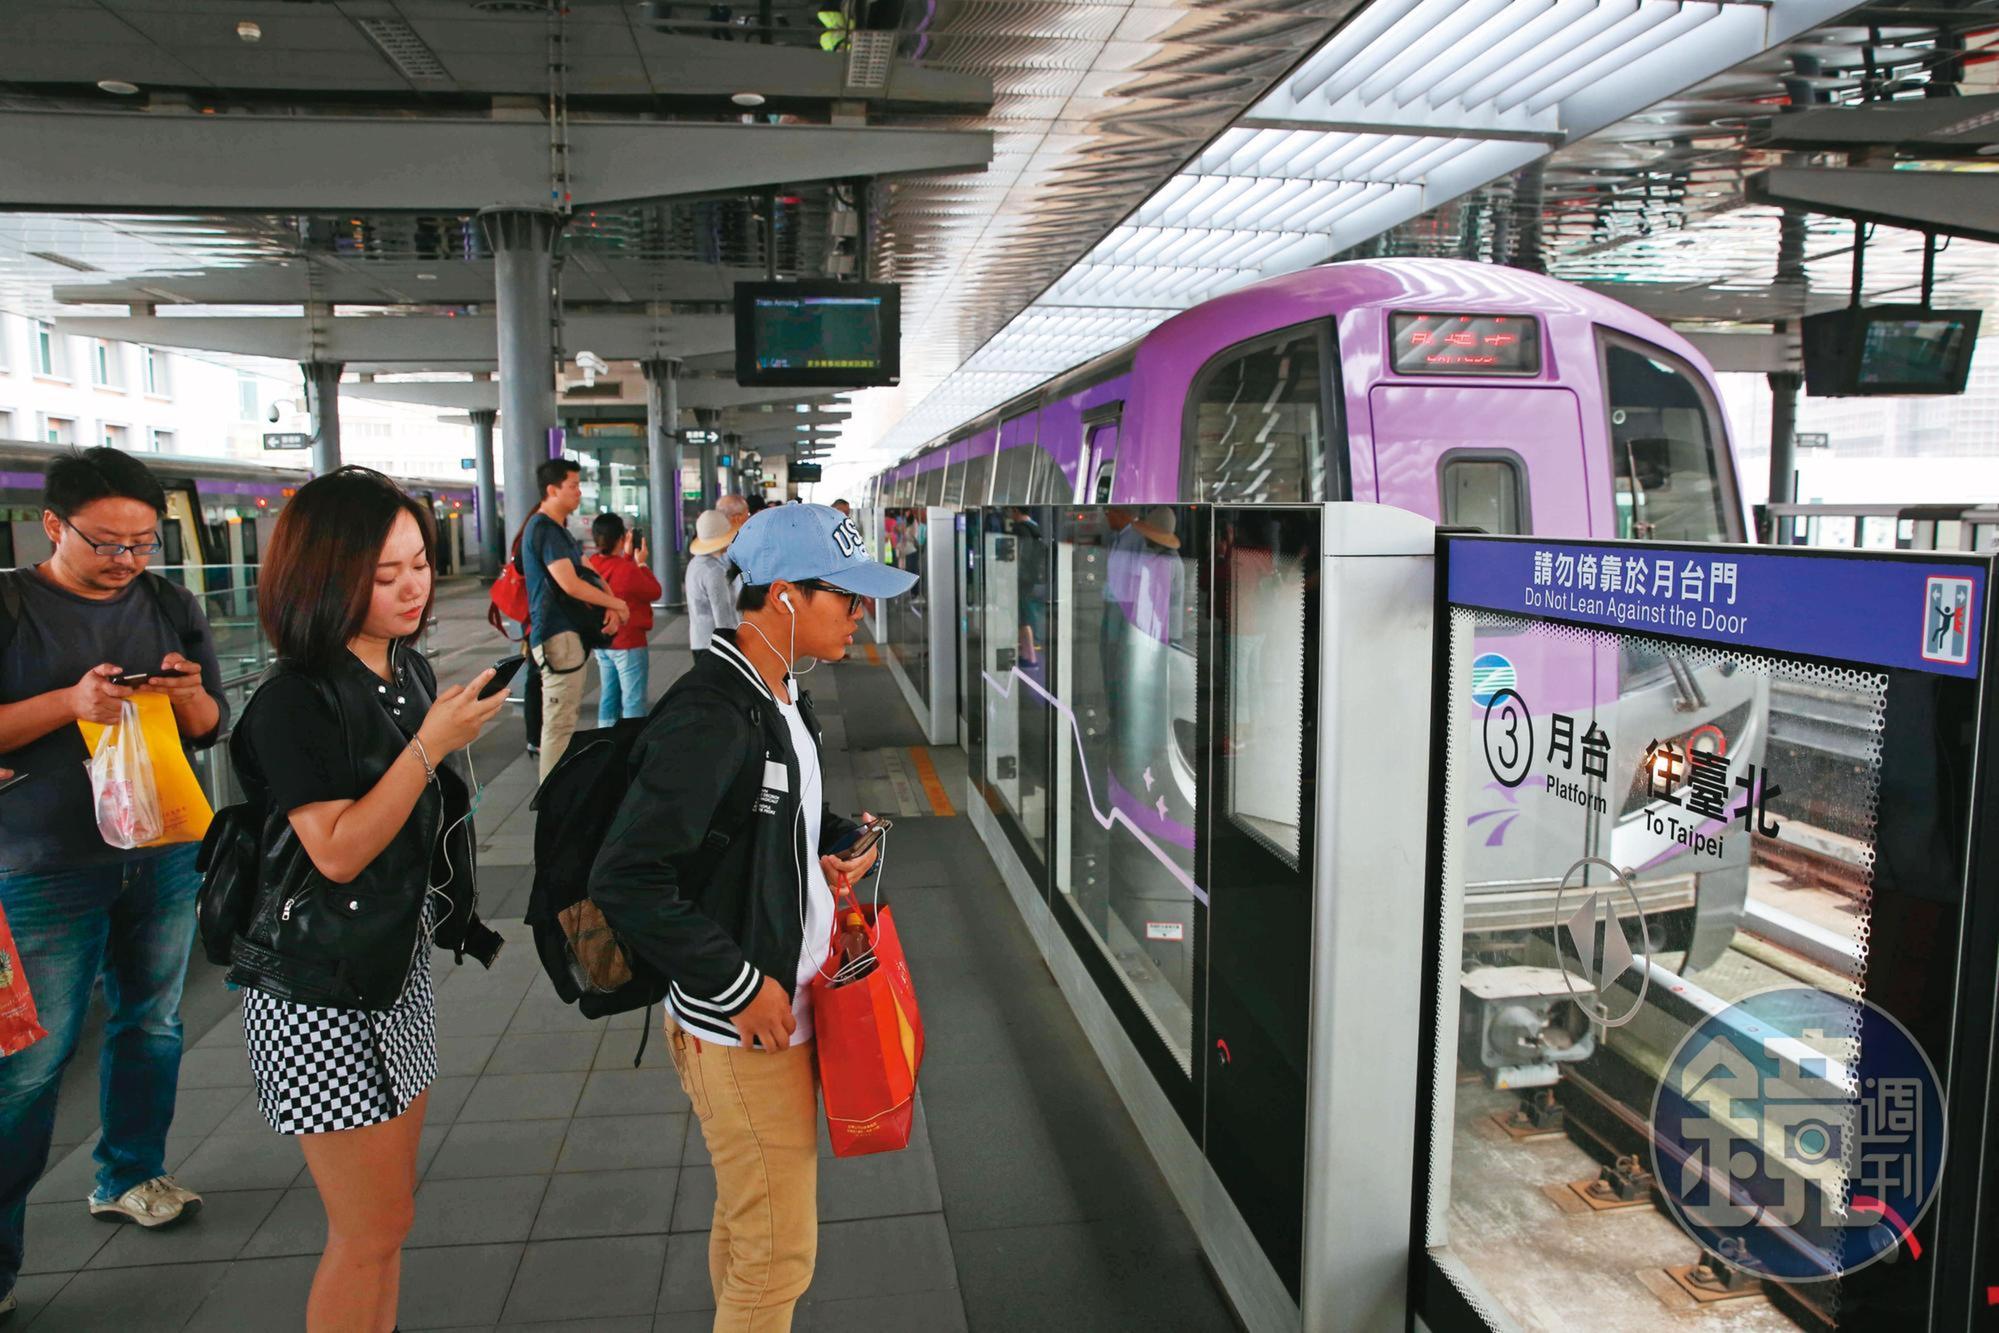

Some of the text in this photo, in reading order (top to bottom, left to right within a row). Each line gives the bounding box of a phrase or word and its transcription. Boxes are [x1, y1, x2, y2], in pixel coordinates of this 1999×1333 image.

[1534, 551, 1738, 605] 請勿倚靠於月台門
[1525, 587, 1748, 634] Do Not Lean Against the Door
[1547, 713, 1612, 783] 月台
[1546, 774, 1607, 814] Platform
[1645, 738, 1782, 839] 往臺北
[1644, 809, 1724, 859] To Taipei
